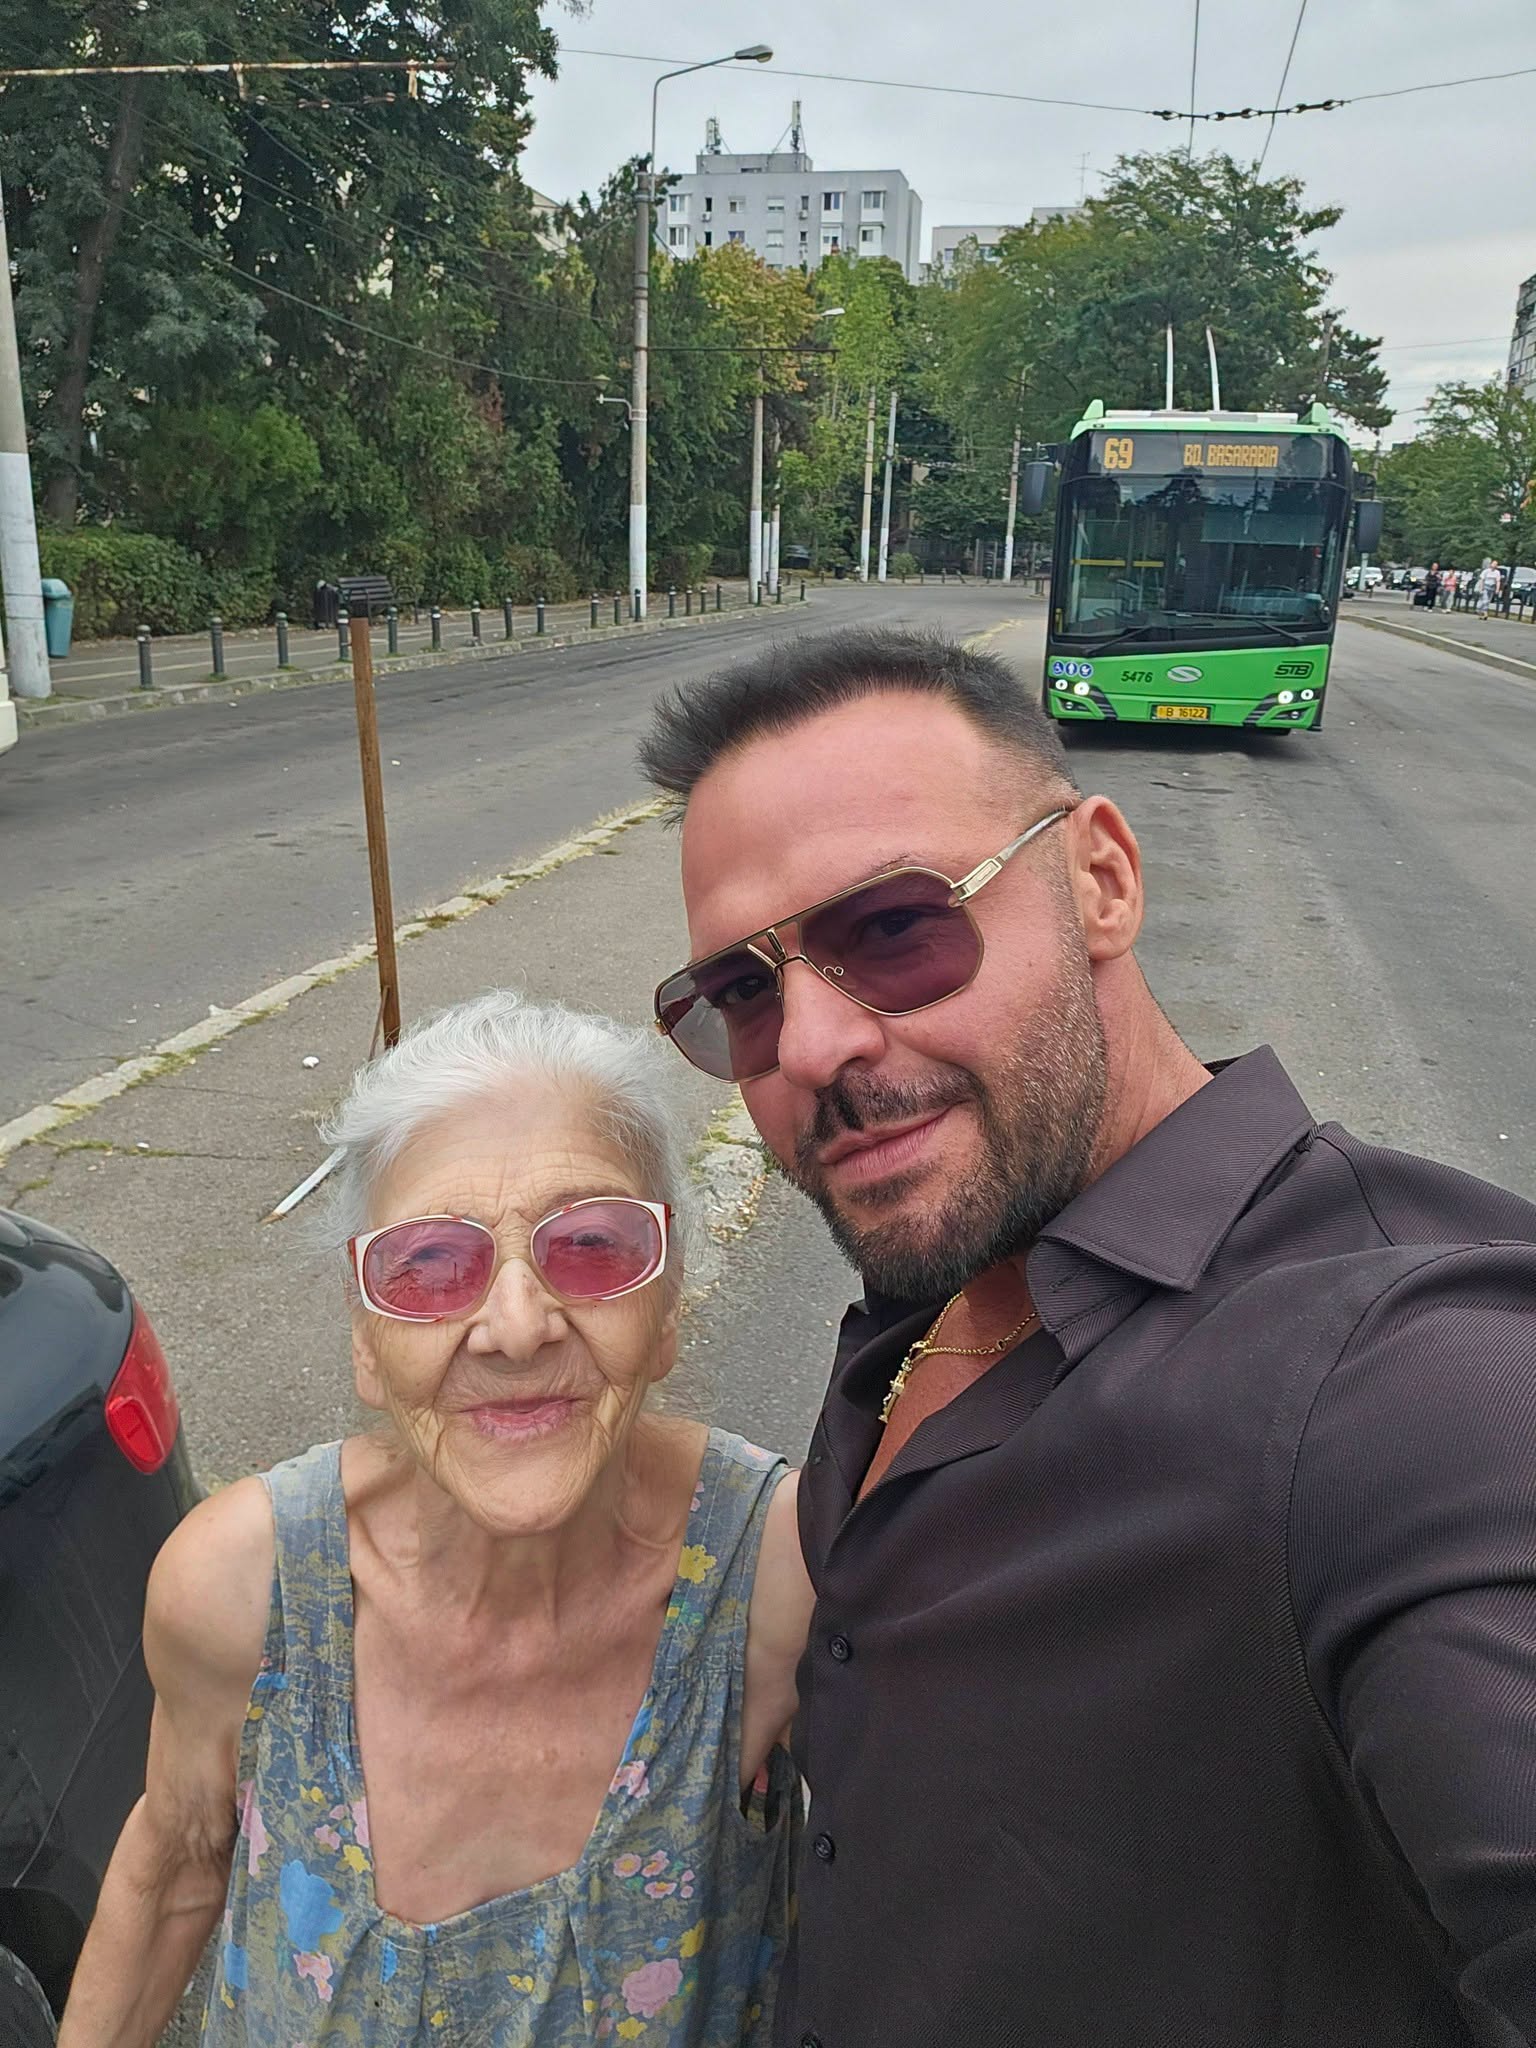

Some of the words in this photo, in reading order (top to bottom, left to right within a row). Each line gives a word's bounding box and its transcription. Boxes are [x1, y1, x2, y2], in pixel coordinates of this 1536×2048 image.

[1103, 438, 1133, 469] 69
[1183, 444, 1204, 466] BD.
[1206, 444, 1279, 468] BASARABIA
[1121, 670, 1153, 683] 5476
[1274, 663, 1311, 677] STB
[1166, 707, 1174, 717] B
[1179, 708, 1205, 718] 16122
